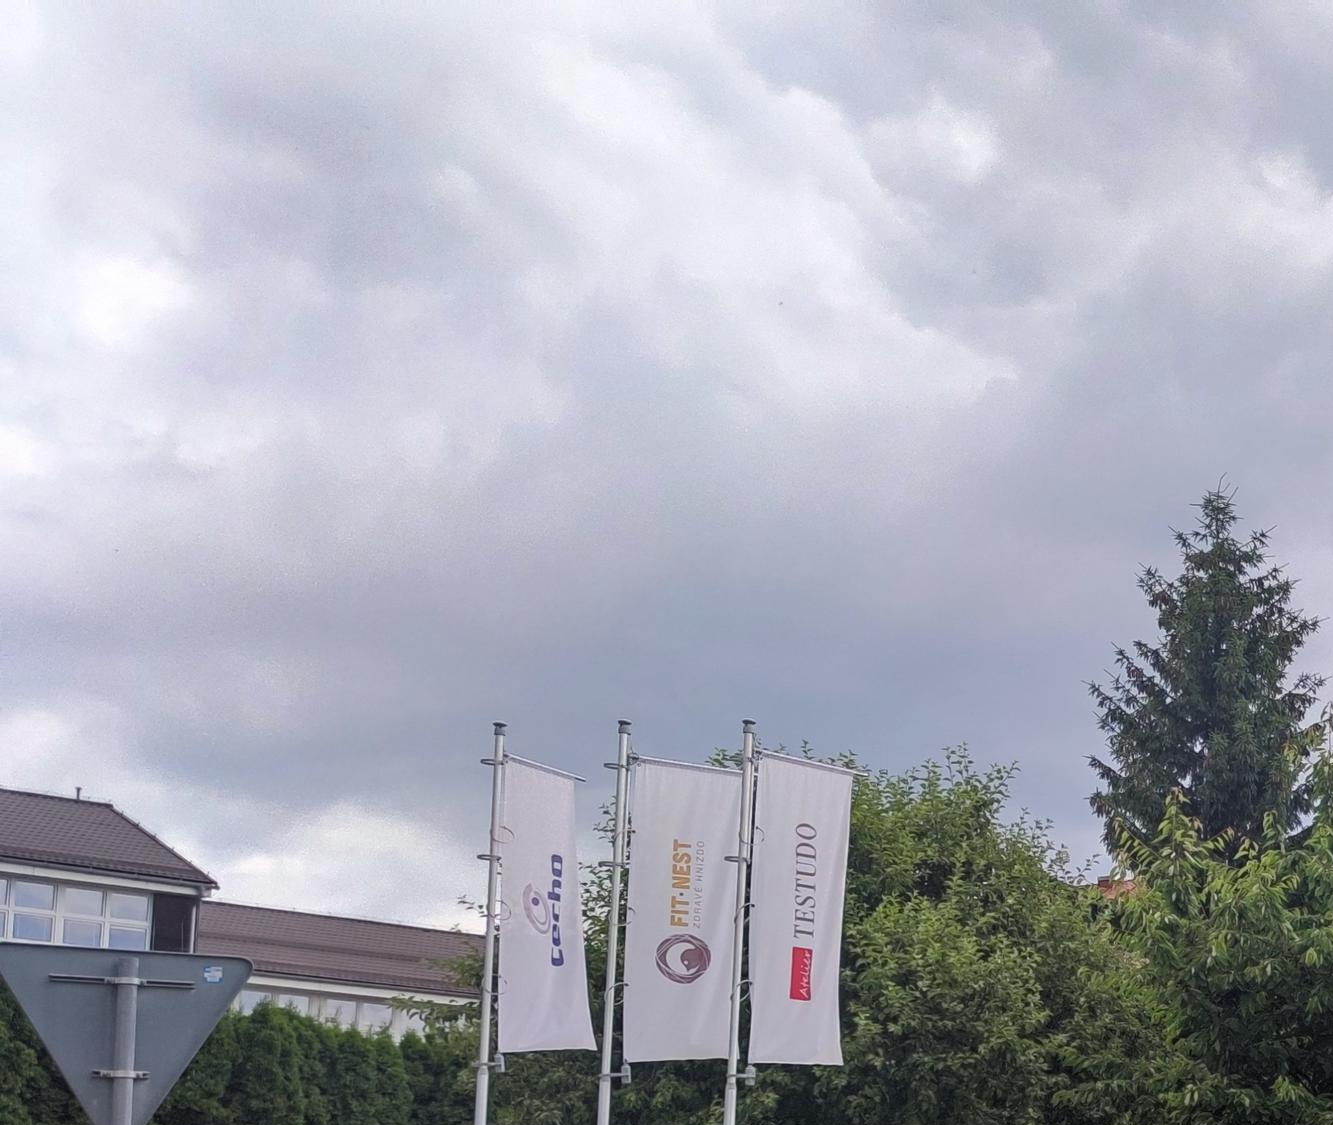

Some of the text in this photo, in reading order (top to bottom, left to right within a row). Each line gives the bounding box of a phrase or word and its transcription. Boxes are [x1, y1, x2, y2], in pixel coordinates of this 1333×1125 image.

[547, 854, 564, 967] cecho
[793, 822, 817, 999] Atelier TESTUDO
